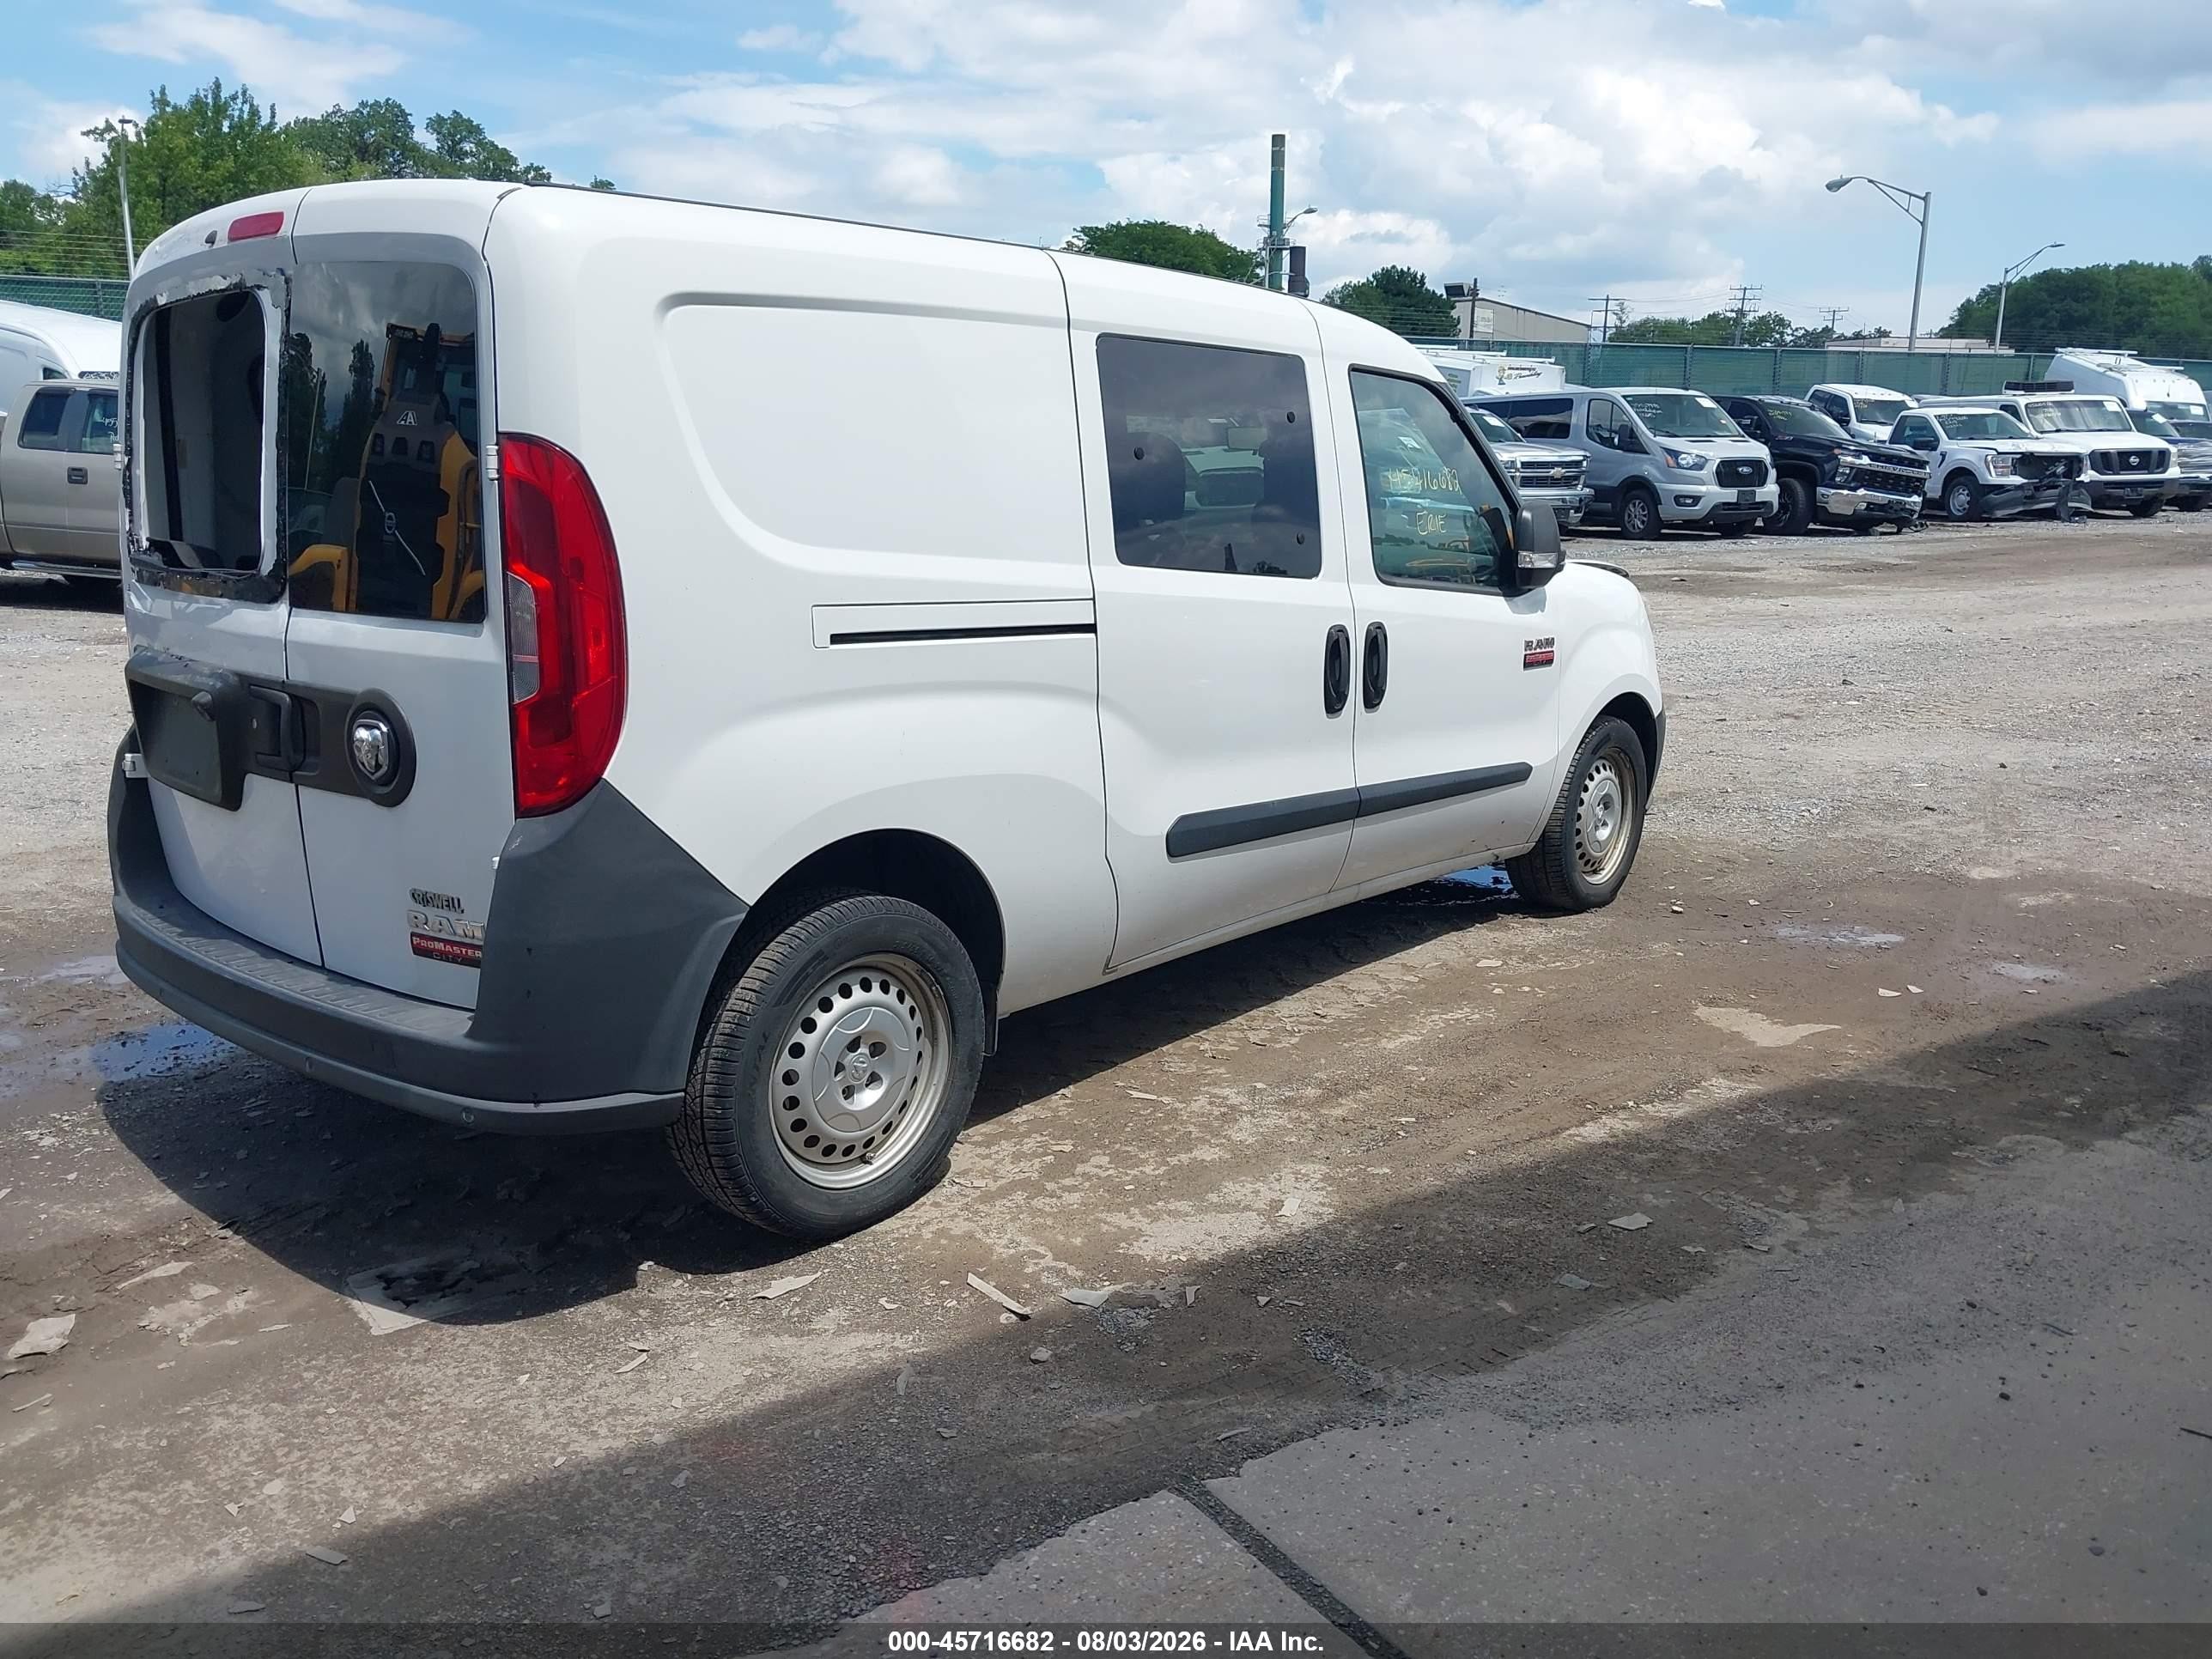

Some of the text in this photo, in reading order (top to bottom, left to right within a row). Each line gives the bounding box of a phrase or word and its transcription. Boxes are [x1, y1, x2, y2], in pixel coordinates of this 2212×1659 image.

[1416, 509, 1448, 536] ERIE
[1523, 636, 1555, 653] RAM
[407, 908, 485, 941] RAM
[433, 951, 463, 963] CITY
